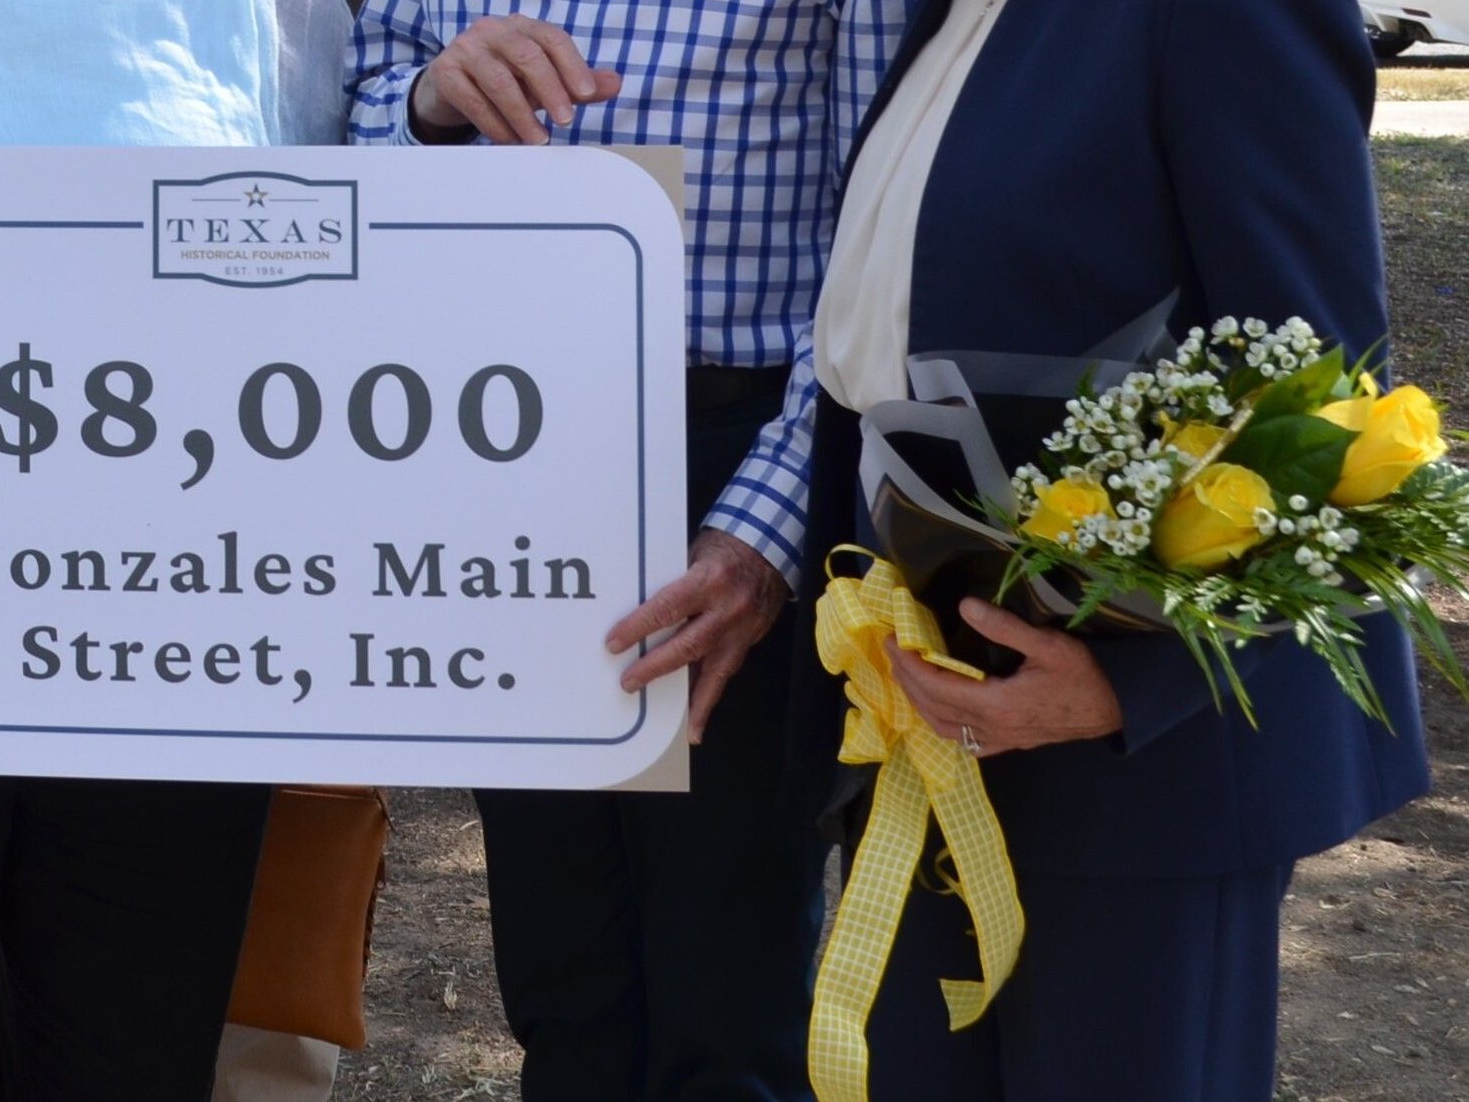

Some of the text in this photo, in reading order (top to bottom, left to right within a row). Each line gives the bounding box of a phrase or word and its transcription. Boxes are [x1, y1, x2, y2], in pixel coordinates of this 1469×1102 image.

[166, 217, 343, 245] TEXAS
[180, 250, 331, 261] HISTORICAL FOUNDATION
[224, 266, 284, 276] EST. 1954
[372, 535, 597, 600] Main
[22, 625, 516, 704] Street, Inc.
